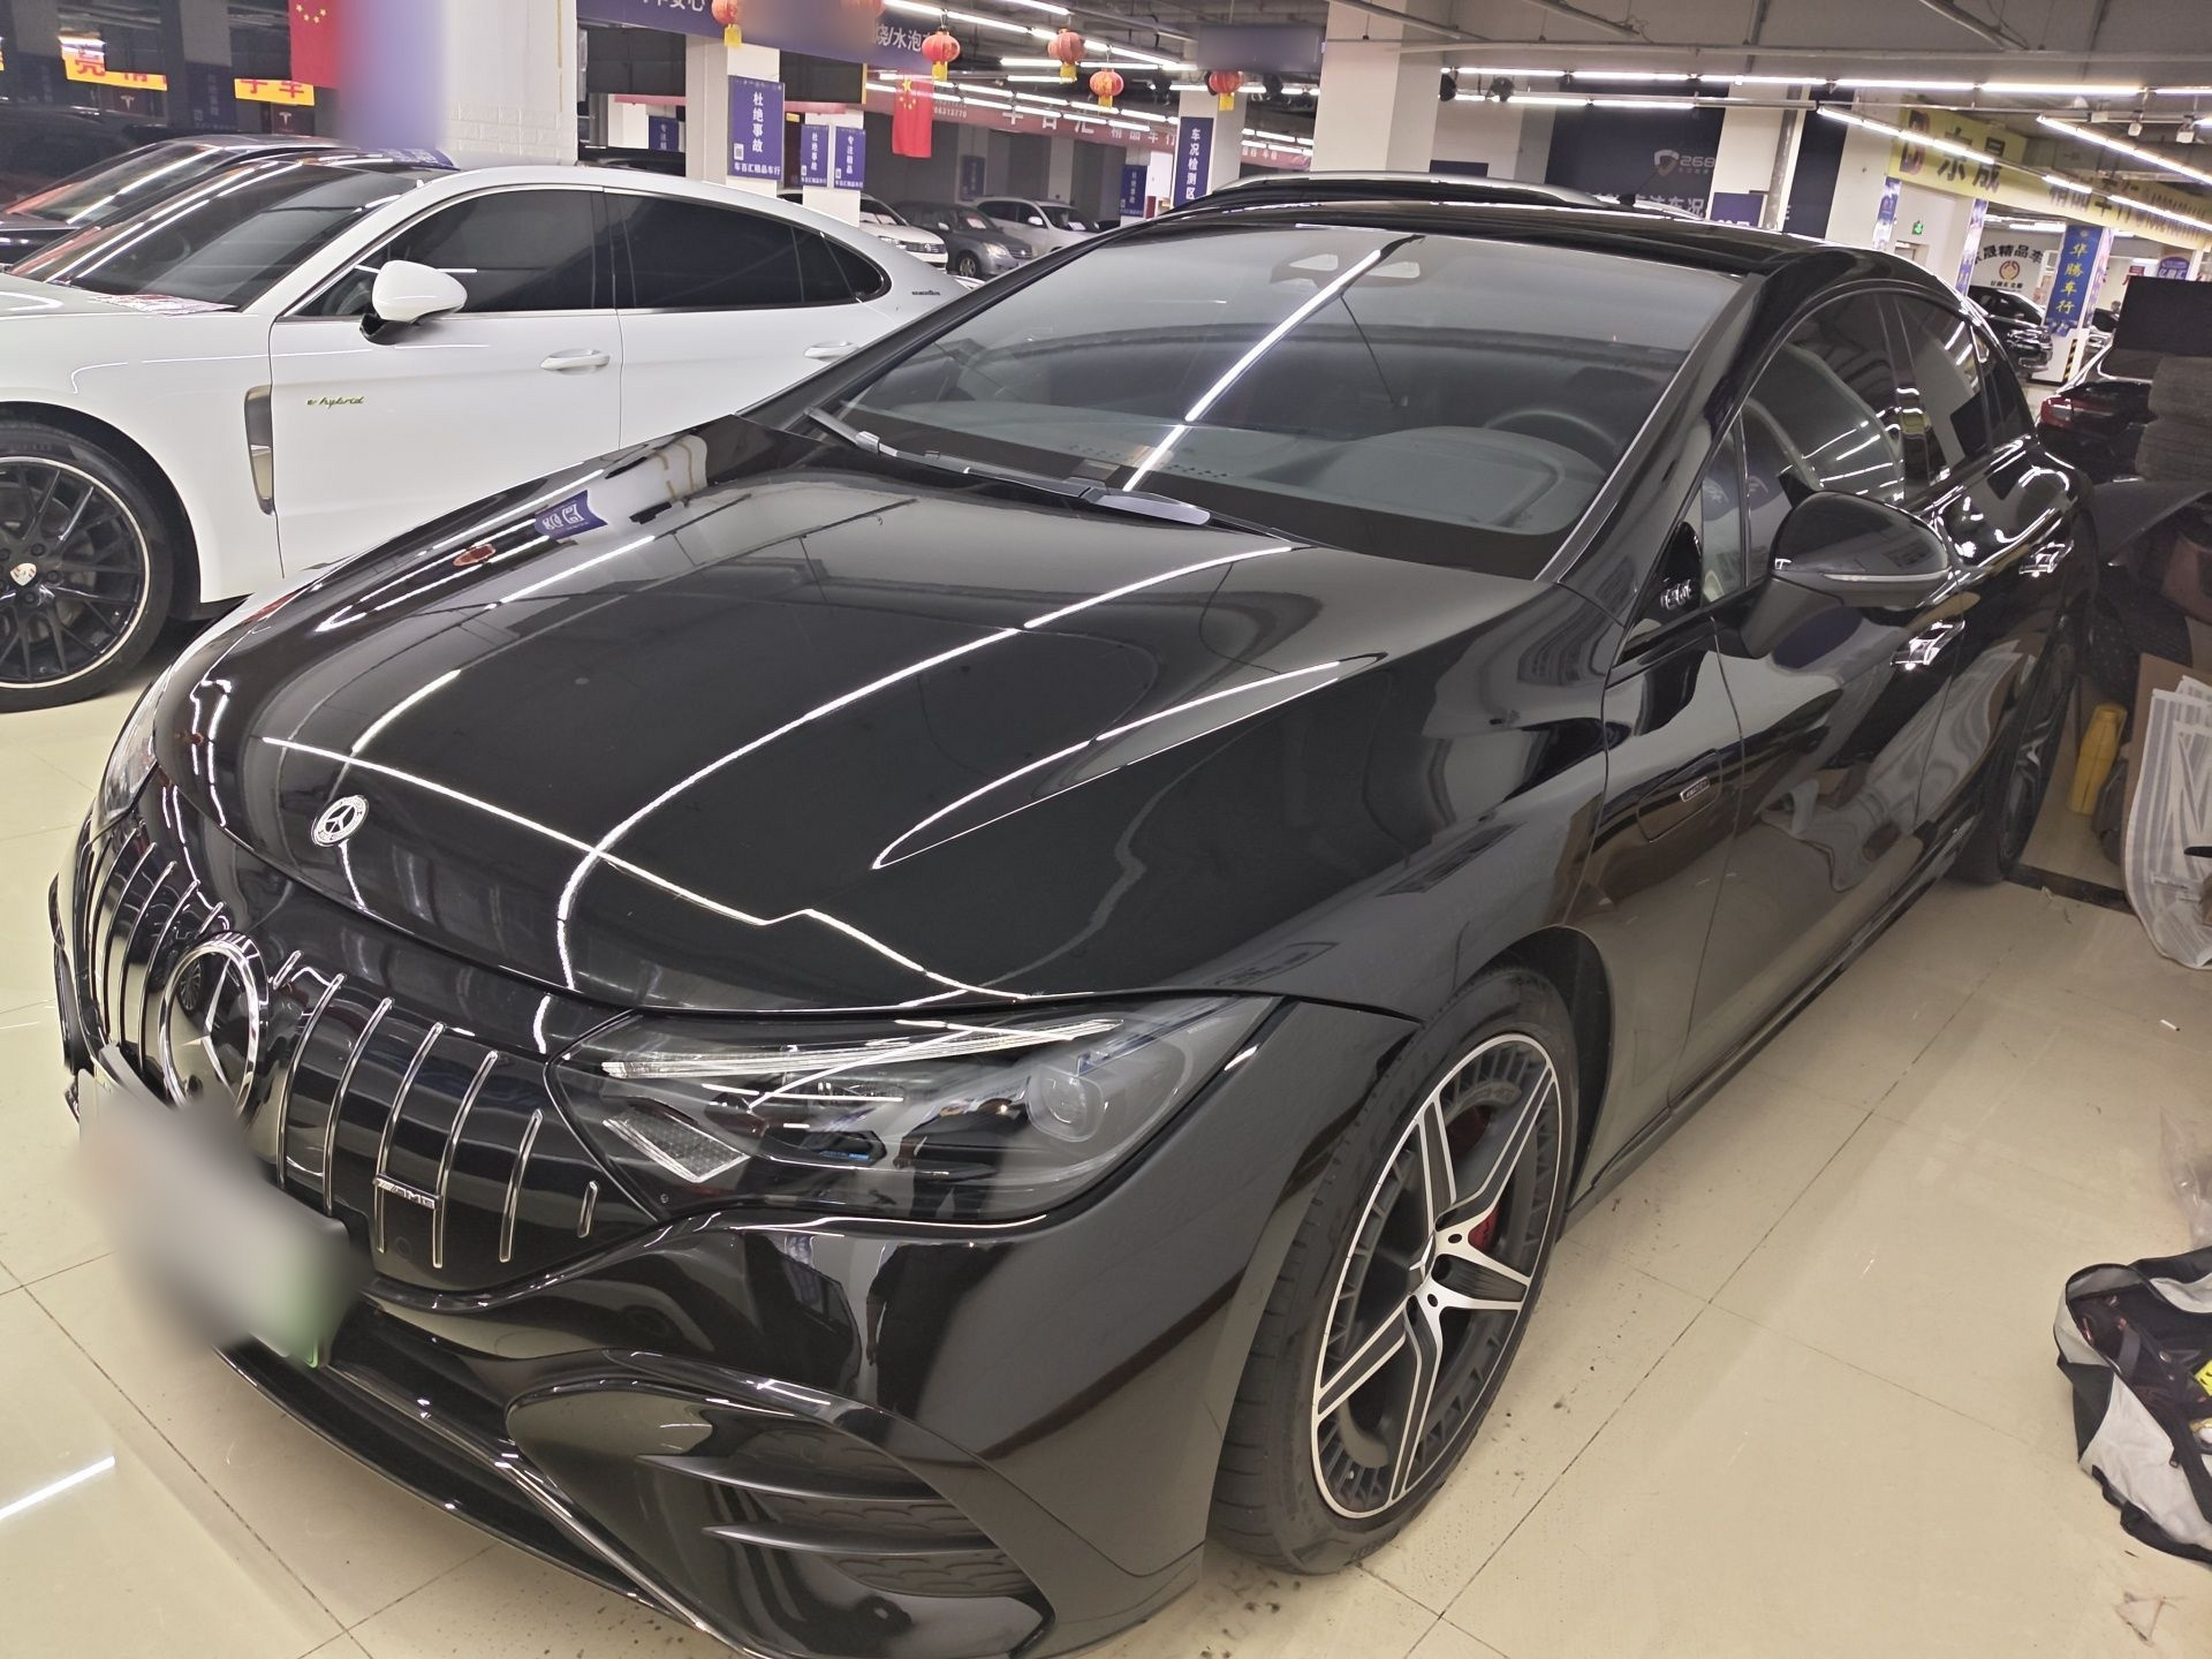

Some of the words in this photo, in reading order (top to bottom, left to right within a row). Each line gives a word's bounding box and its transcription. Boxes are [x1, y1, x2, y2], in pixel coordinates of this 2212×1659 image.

[752, 91, 764, 153] 杜绝事故
[1185, 128, 1201, 200] 车况检测区
